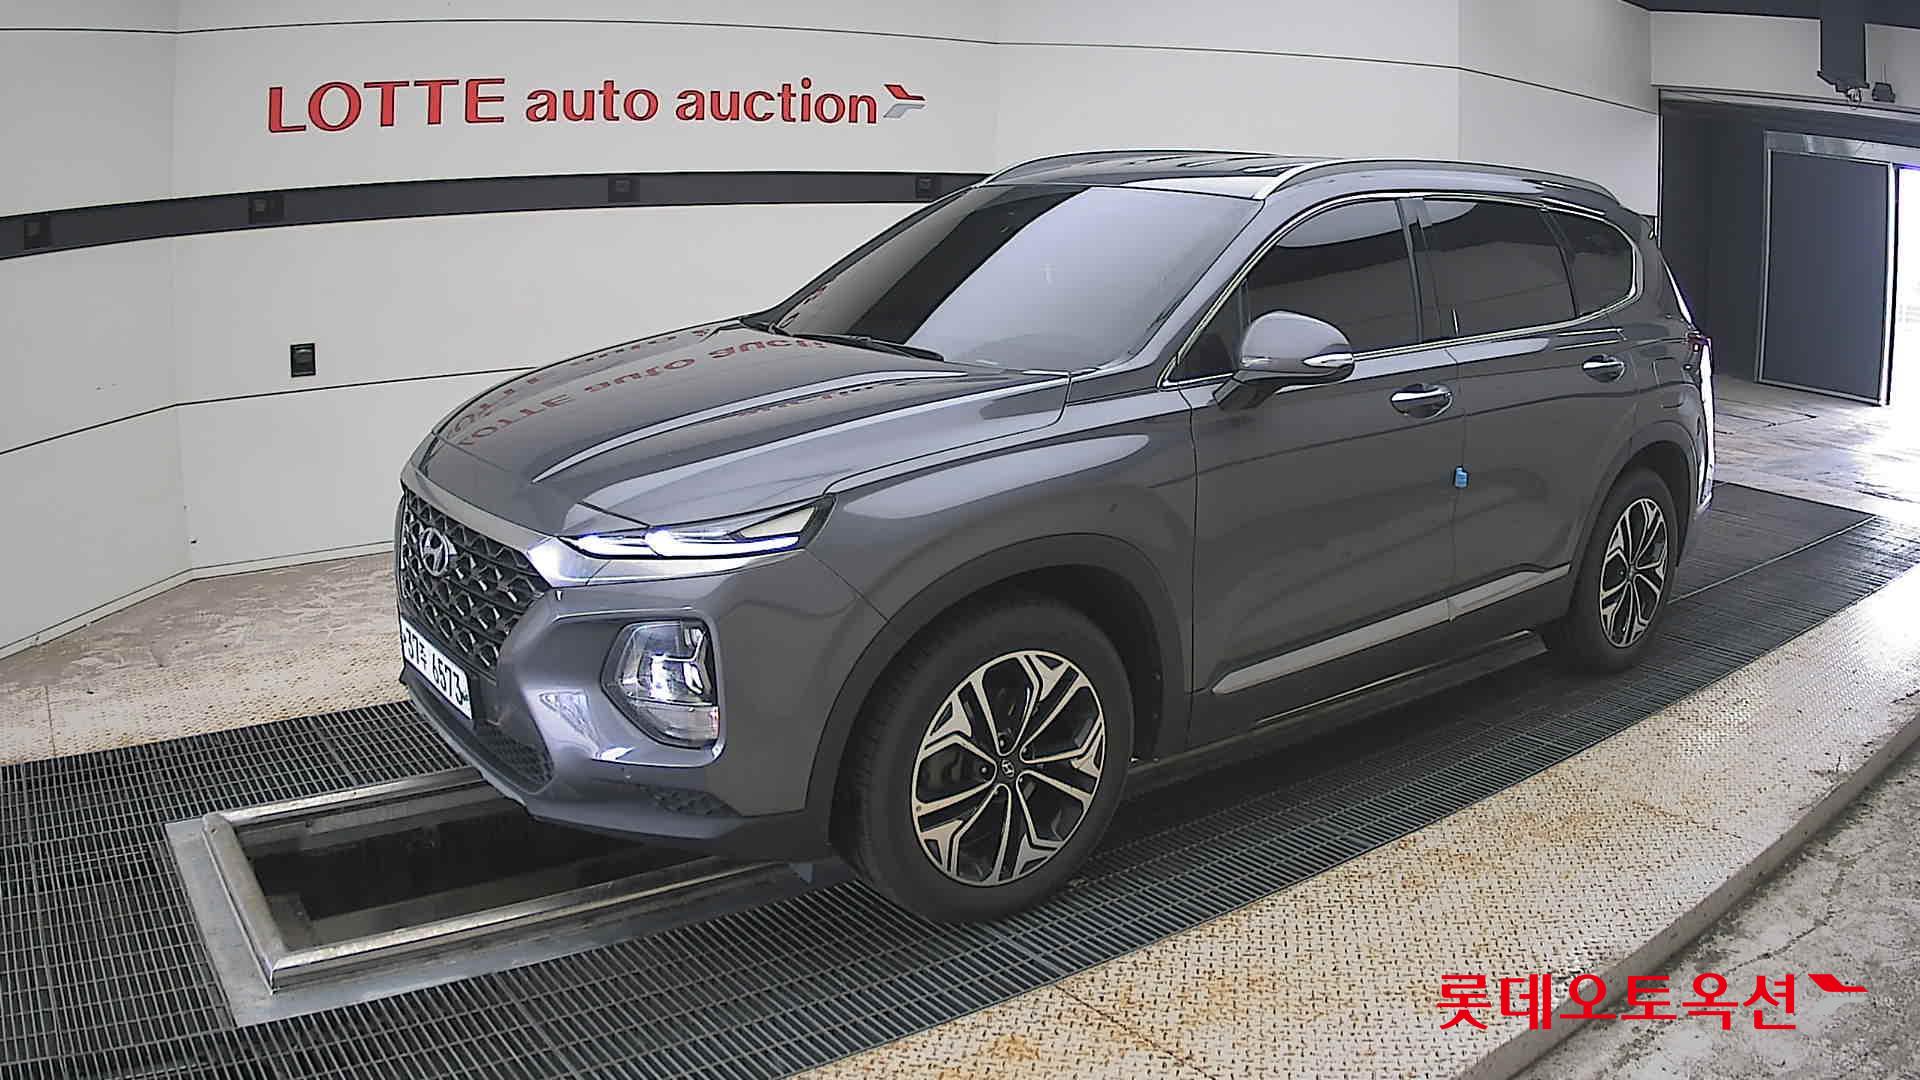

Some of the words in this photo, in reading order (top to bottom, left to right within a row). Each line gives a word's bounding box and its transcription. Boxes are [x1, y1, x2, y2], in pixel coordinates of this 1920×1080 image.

[267, 78, 506, 133] LOTTE
[525, 80, 659, 123] auto
[674, 78, 878, 124] auction
[432, 653, 464, 706] 6573
